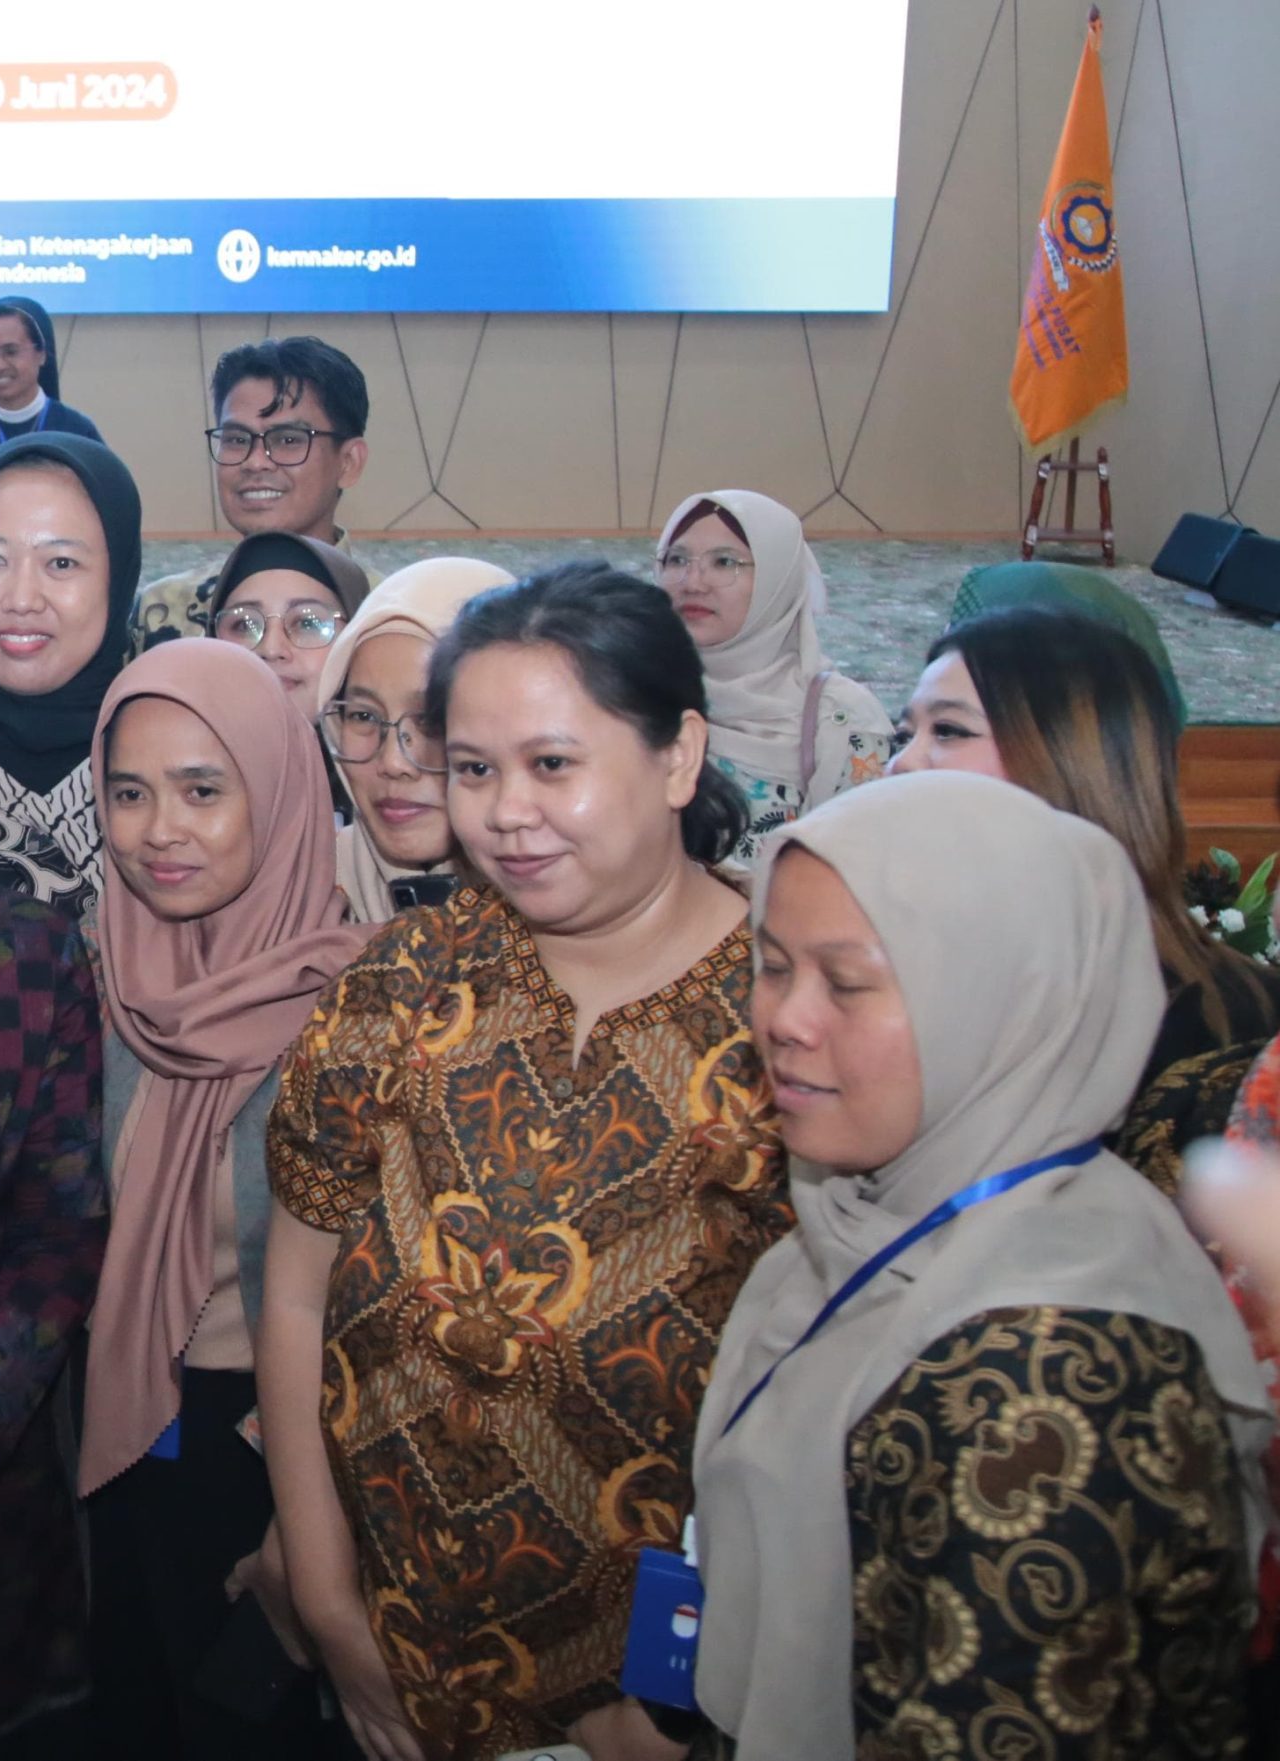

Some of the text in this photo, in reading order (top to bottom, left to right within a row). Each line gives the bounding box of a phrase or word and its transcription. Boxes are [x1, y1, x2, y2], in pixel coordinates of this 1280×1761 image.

[12, 75, 75, 109] Juni
[82, 74, 166, 108] 2024
[30, 235, 192, 260] Ketenagakerjaan
[267, 245, 416, 272] kemnaker.go.id
